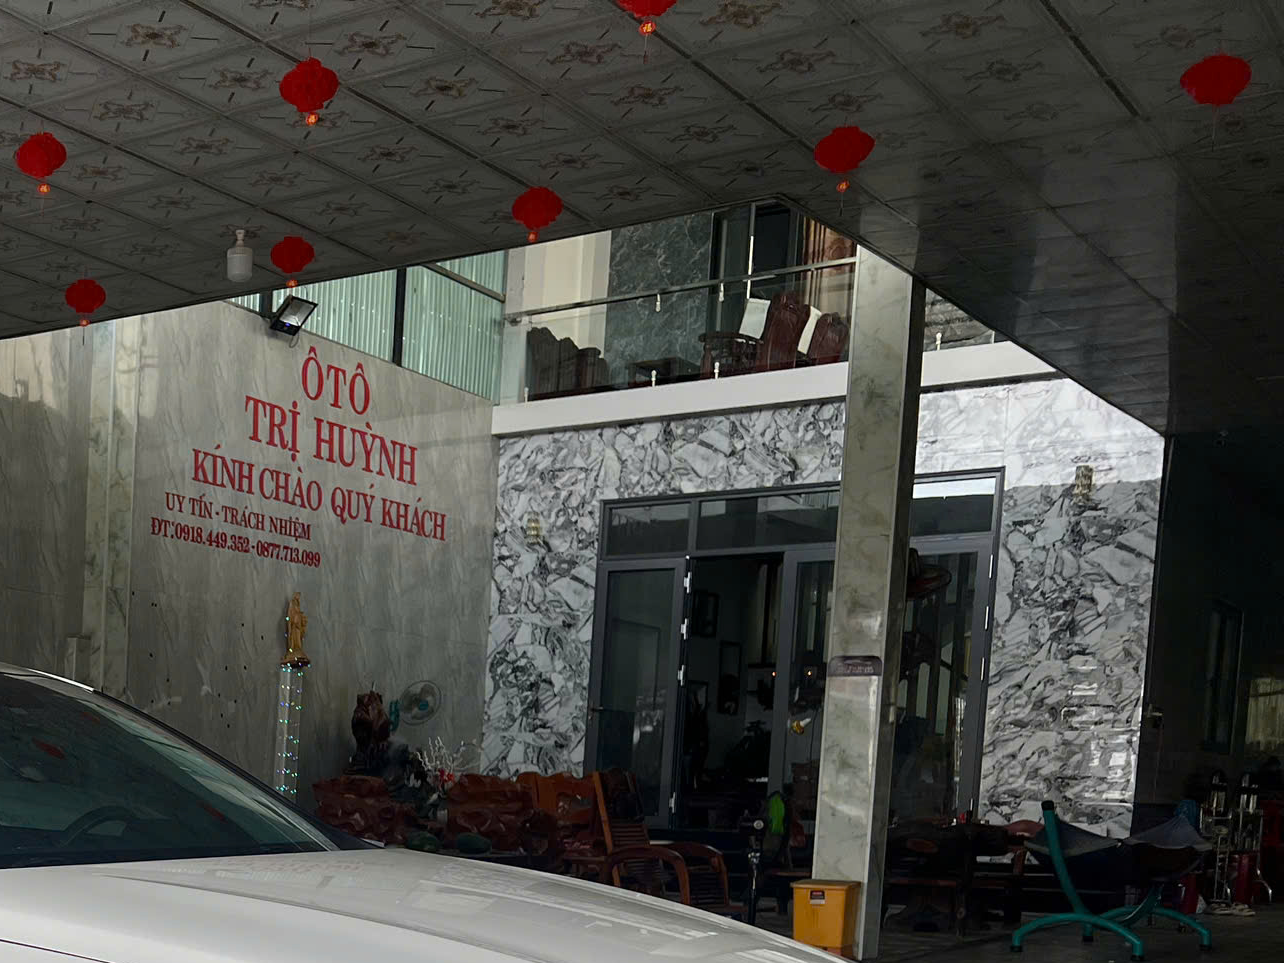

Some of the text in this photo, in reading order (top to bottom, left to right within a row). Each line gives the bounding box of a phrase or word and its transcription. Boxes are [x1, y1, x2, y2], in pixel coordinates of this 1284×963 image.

[301, 345, 371, 416] ÔTÔ
[313, 417, 418, 486] HUỲNH
[165, 491, 185, 514] UY
[189, 493, 214, 520] TÍN
[221, 505, 266, 532] TRÁCH
[192, 443, 446, 541] KÍNH CHÀO QUÝ KHÁCH
